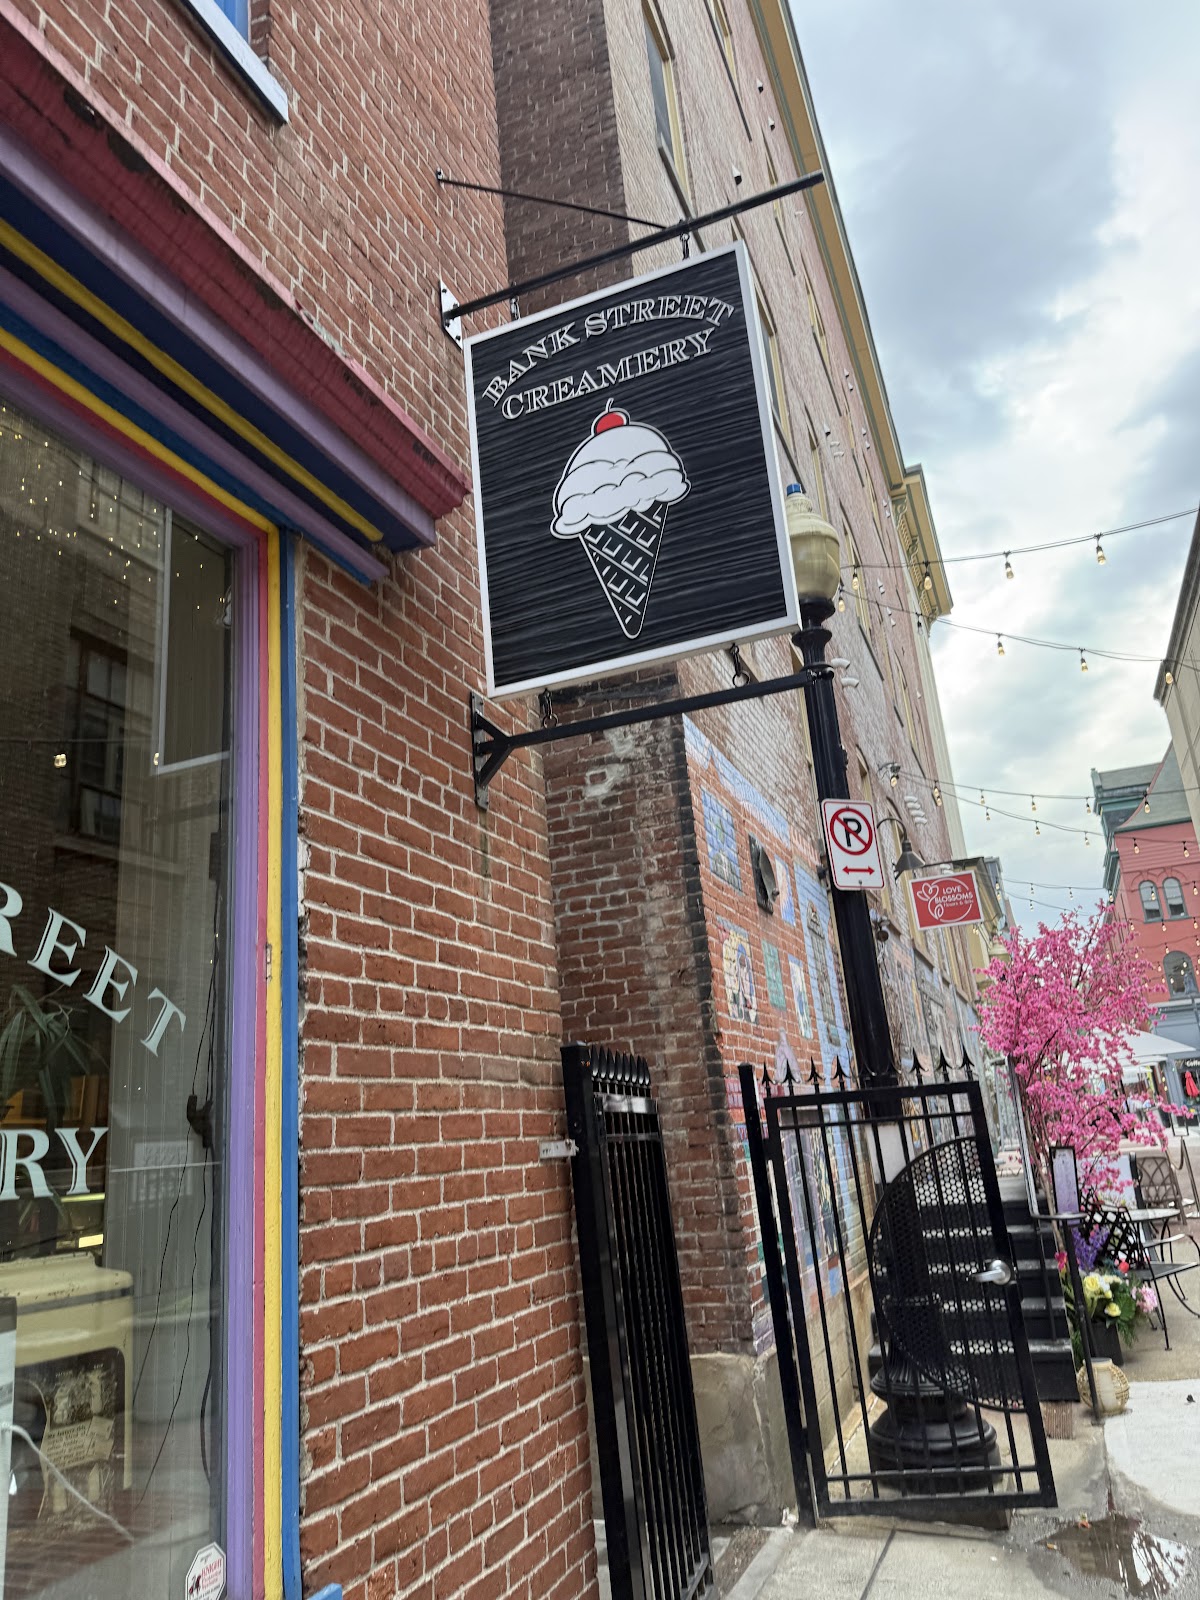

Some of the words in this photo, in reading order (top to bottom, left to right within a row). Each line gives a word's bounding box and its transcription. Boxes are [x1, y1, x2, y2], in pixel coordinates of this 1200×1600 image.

[482, 321, 581, 407] BANK
[584, 294, 734, 340] STREET
[502, 327, 715, 420] CREAMERY
[842, 817, 862, 847] P
[934, 891, 974, 904] BLOSSOMS
[942, 885, 962, 895] LOVE
[0, 1127, 109, 1199] RY
